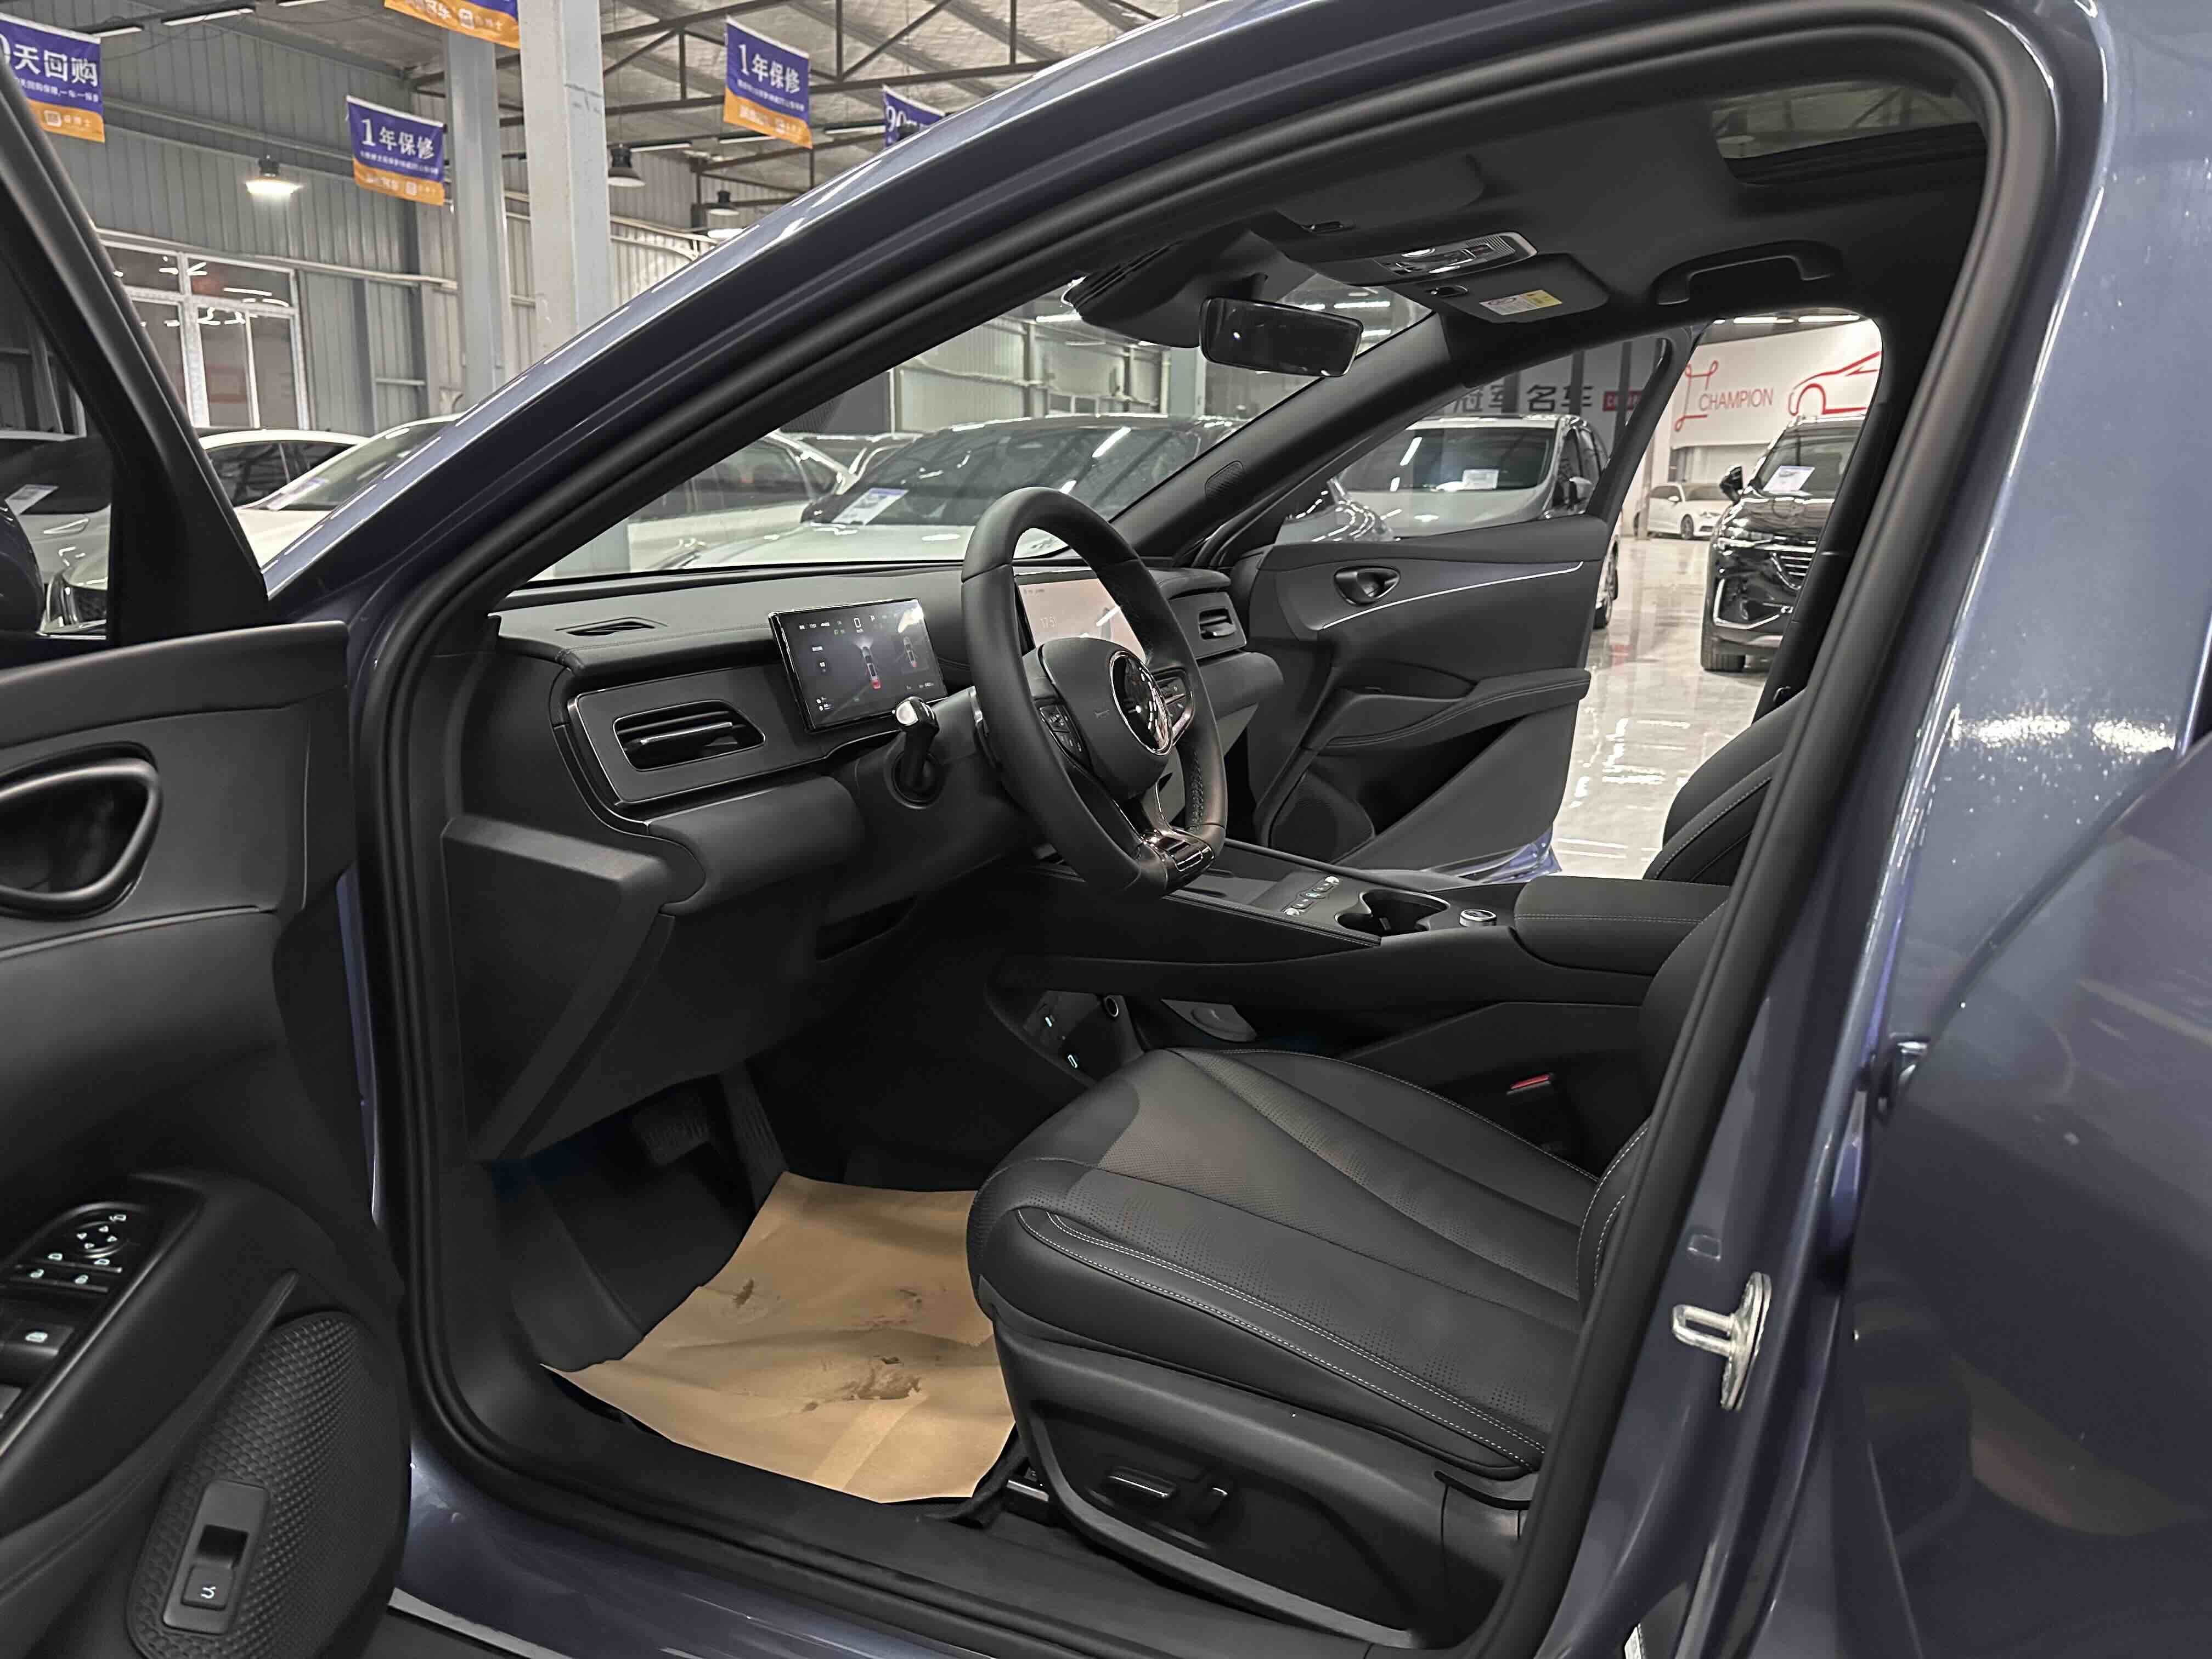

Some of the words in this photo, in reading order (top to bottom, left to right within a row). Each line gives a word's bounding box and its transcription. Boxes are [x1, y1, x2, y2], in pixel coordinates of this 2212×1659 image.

[738, 44, 800, 93] 1年保修
[360, 119, 435, 159] 1年保修
[1699, 388, 1774, 411] CHAMPION
